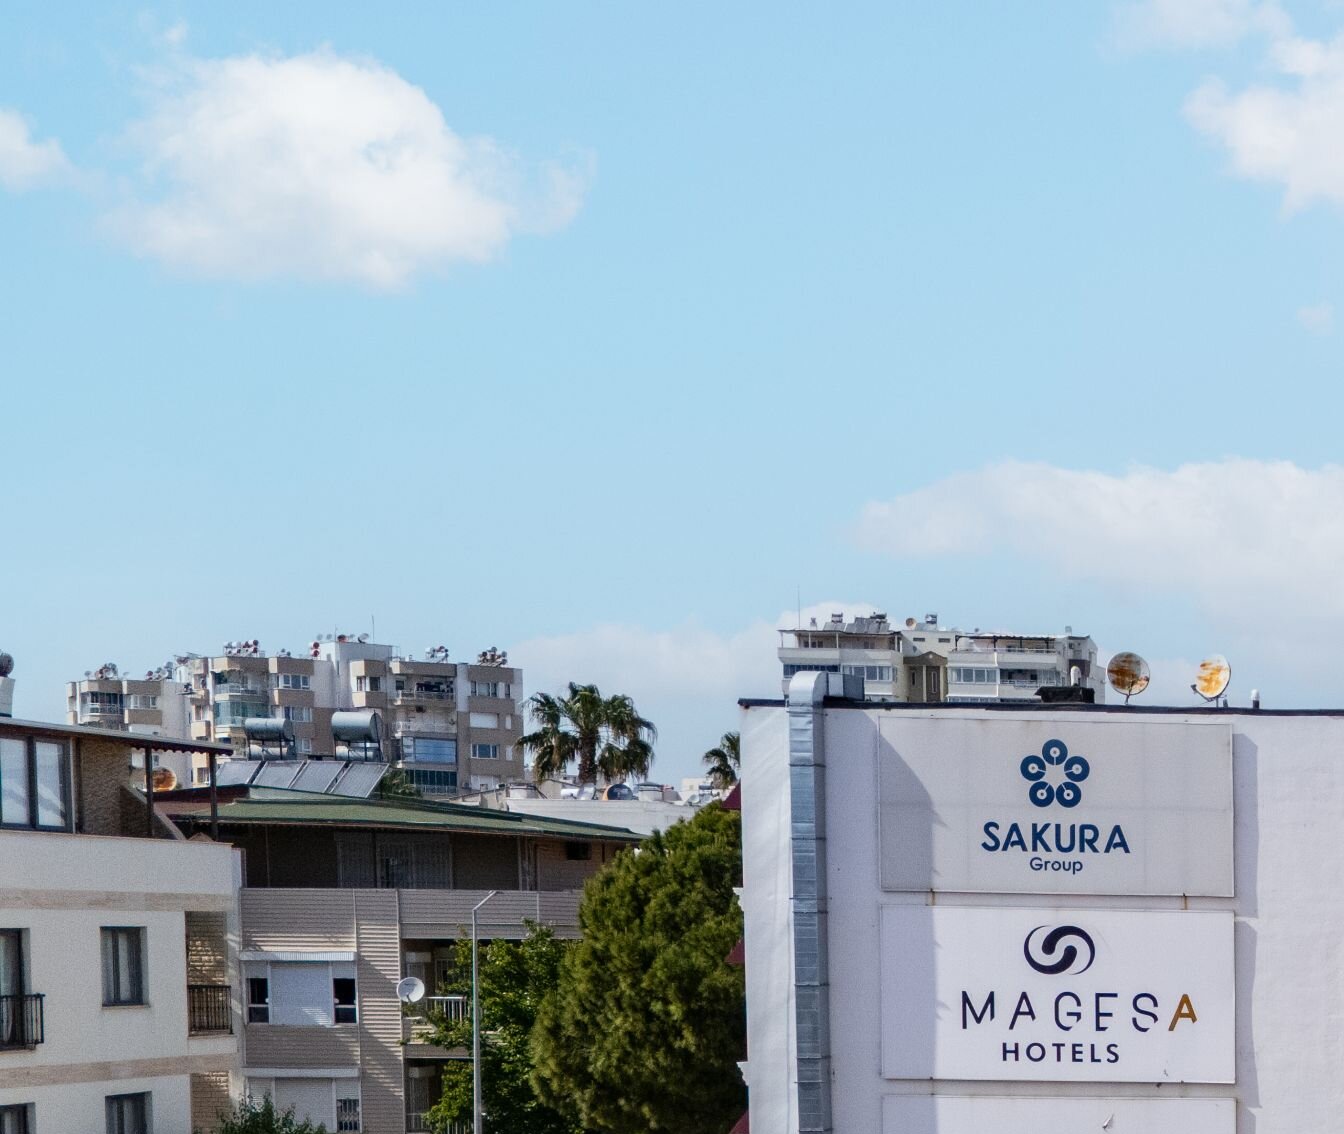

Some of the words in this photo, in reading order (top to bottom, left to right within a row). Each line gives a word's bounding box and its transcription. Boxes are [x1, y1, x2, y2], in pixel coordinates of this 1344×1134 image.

[981, 821, 1131, 853] SAKURA
[1029, 857, 1083, 875] Group
[961, 991, 1197, 1032] MAGESA
[1002, 1043, 1120, 1063] HOTELS
